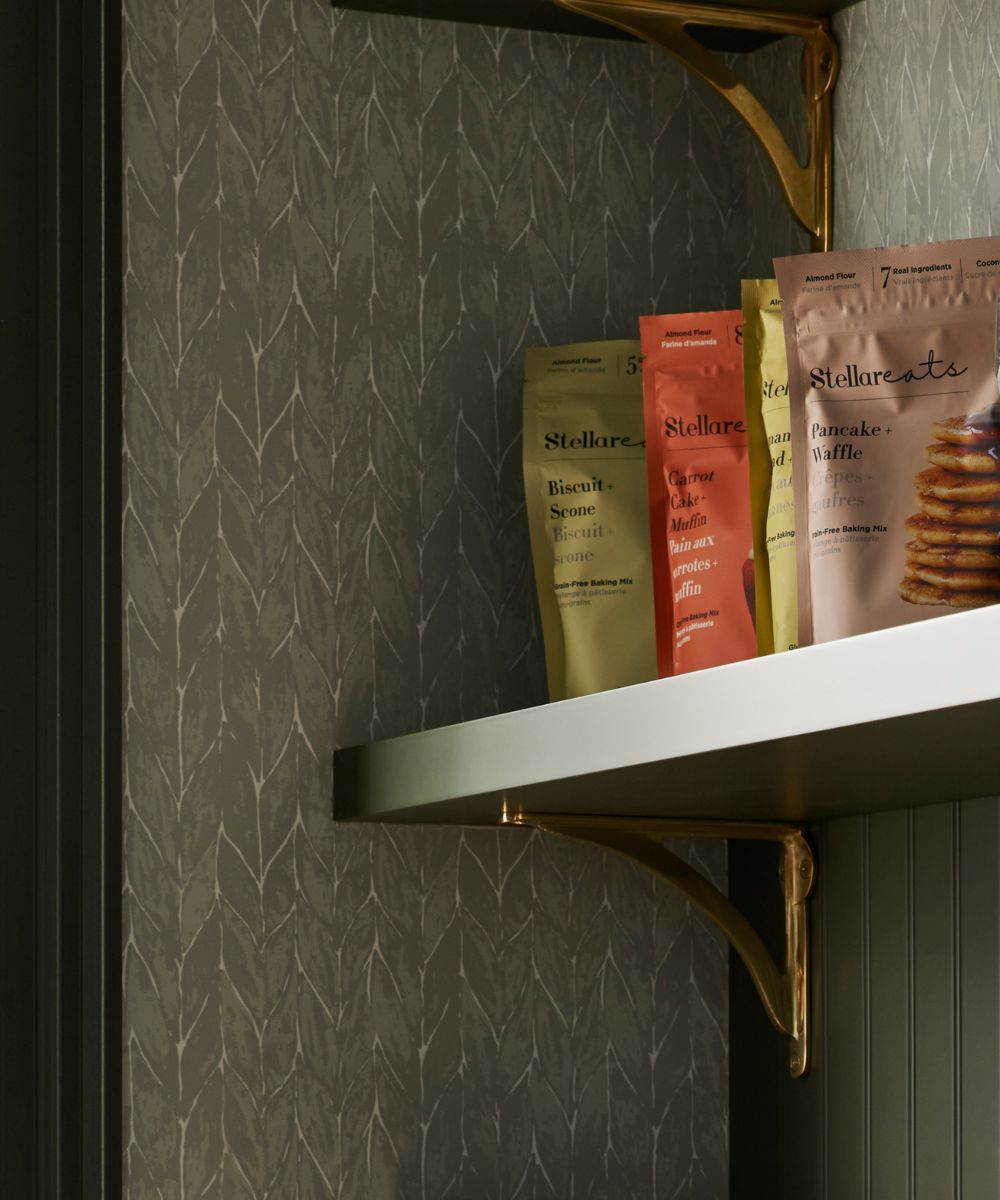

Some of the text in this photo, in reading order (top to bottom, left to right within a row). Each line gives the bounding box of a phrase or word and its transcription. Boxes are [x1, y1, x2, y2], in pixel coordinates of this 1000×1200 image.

[805, 272, 856, 282] Almond Flour
[880, 263, 952, 288] 7 Real Ingredients
[665, 330, 692, 338] Almond
[661, 338, 718, 348] Farine d'amande
[626, 356, 637, 375] 5
[810, 350, 968, 390] Stellareats
[812, 421, 881, 439] Pancake
[812, 444, 862, 464] Waffle
[547, 476, 603, 496] Biscuit
[668, 470, 715, 486] Carrot
[670, 492, 700, 510] Cake
[550, 504, 596, 520] Scone
[670, 512, 708, 532] Muffin
[842, 525, 870, 533] Baking
[552, 522, 603, 542] Biscuit
[776, 530, 796, 541] Baking
[669, 536, 716, 556] Pain aux
[554, 552, 594, 564] scone
[590, 579, 618, 587] Baking
[690, 612, 708, 621] Baking
